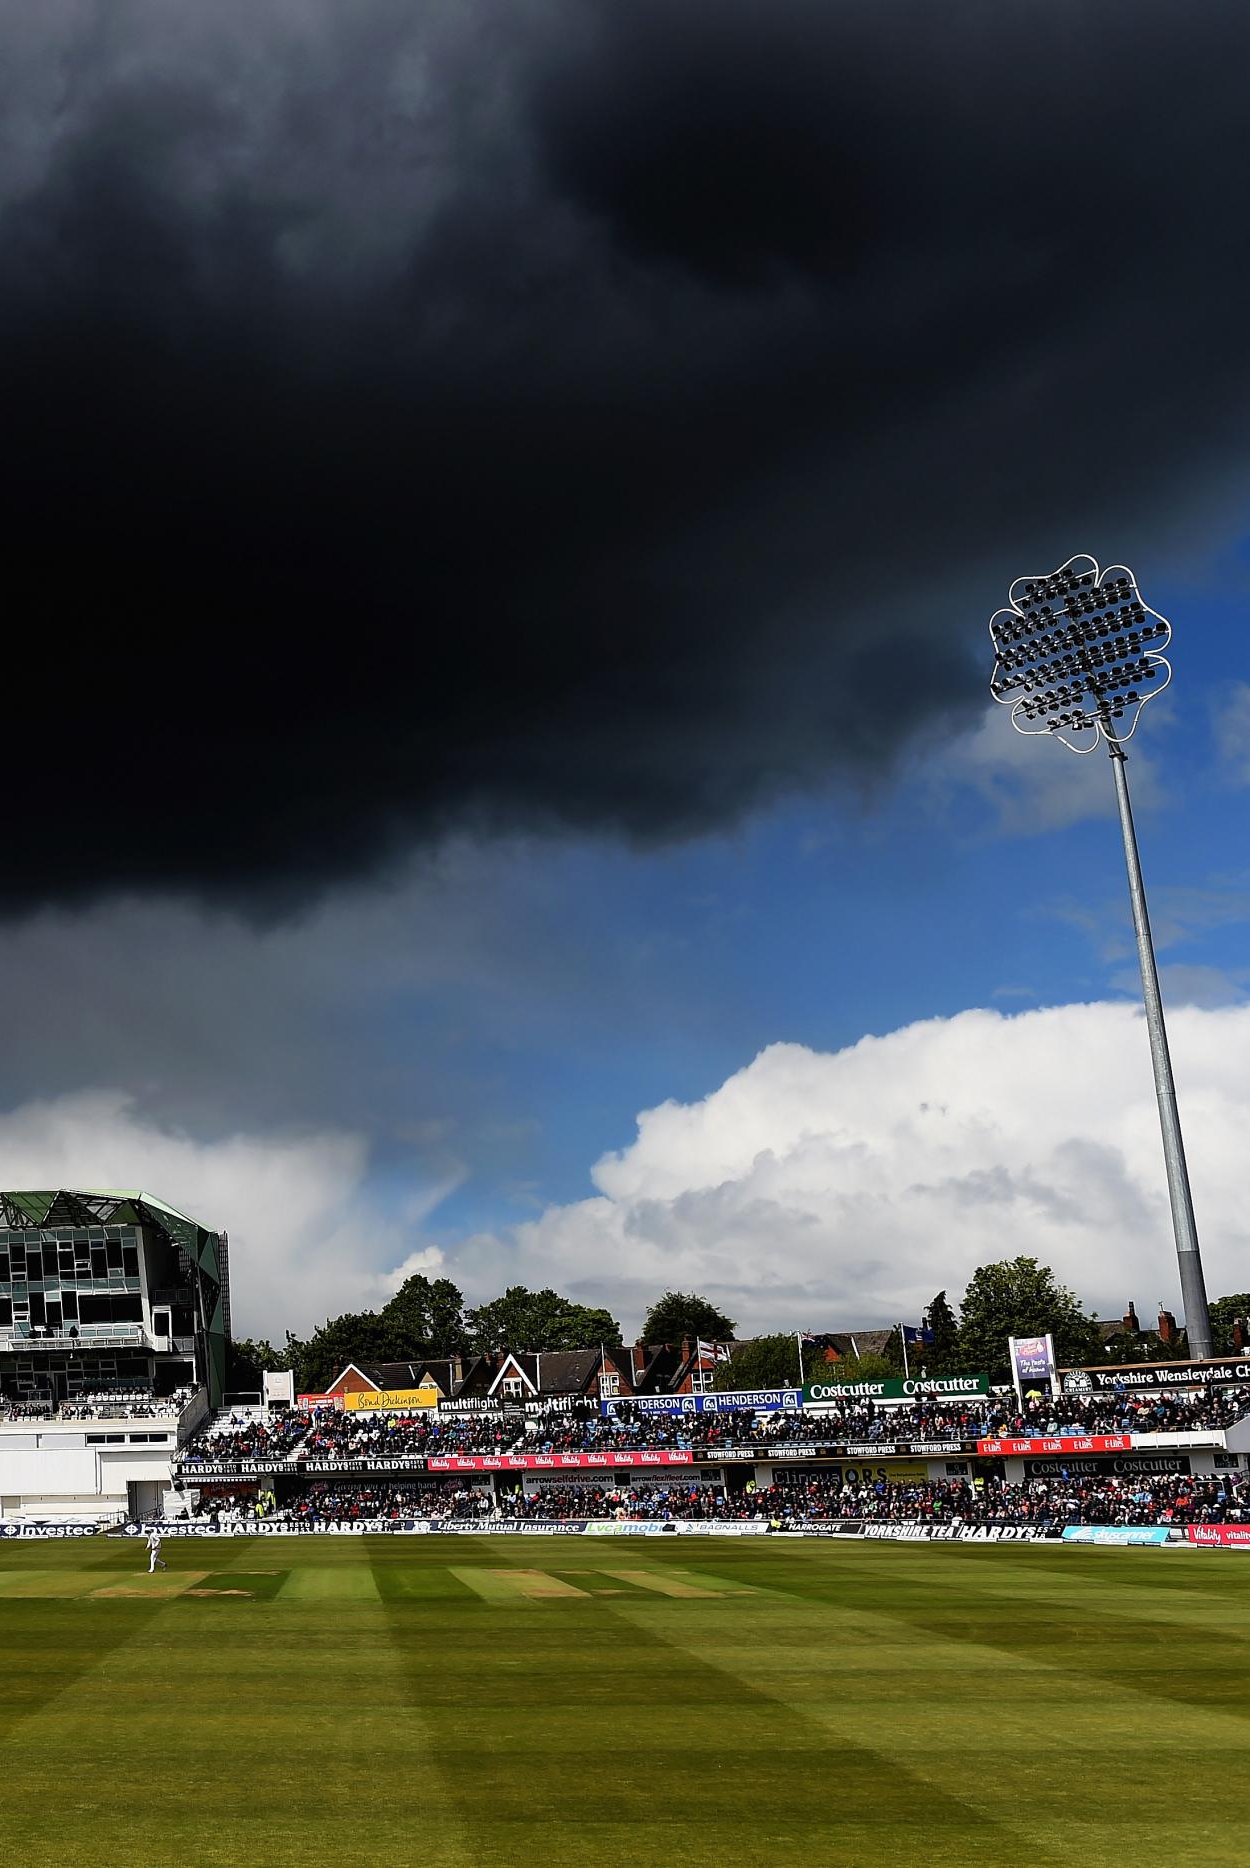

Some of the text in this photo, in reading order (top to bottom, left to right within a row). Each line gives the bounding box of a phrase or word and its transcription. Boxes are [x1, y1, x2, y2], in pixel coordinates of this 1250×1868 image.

[1096, 1372, 1154, 1386] Yorkshire
[1155, 1366, 1233, 1383] Wensleydale
[810, 1383, 884, 1399] Costcutter
[902, 1378, 979, 1395] Costcutter
[357, 1391, 422, 1409] Bond Dickinson
[440, 1397, 499, 1411] multiflight
[719, 1393, 781, 1406] HENDERSON
[768, 1448, 816, 1457] STOWFORD PRESS
[847, 1445, 896, 1455] STOWFORD PRESS
[910, 1443, 961, 1453] STOWFORD PRESS
[561, 1454, 580, 1466] Vitality
[588, 1454, 607, 1466] Vitality
[614, 1453, 634, 1464] Vitality
[641, 1452, 660, 1463] Vitality
[668, 1451, 688, 1463] Vitality
[707, 1450, 754, 1459] STOWFORD PRESS
[306, 1462, 349, 1471] HARDYS
[367, 1460, 410, 1470] HARDYS
[432, 1457, 450, 1469] Vitality
[457, 1457, 475, 1468] Vitality
[483, 1456, 501, 1468] Vitality
[509, 1455, 527, 1467] Vitality
[535, 1455, 554, 1467] Vitality
[1113, 1459, 1182, 1472] Costcutter
[182, 1465, 223, 1474] HARDYS
[241, 1463, 283, 1473] HARDYS
[1031, 1461, 1098, 1475] Costcutter
[526, 1474, 613, 1484] arrowselfdrive.com
[632, 1474, 700, 1482] arrowflexifleet.com
[774, 1471, 841, 1484] Clinova
[334, 1482, 361, 1491] Giving
[388, 1482, 417, 1491] helping
[417, 1481, 437, 1489] hand
[19, 1524, 94, 1536] Investec
[140, 1523, 216, 1535] Investec
[219, 1522, 288, 1533] HARDYS
[313, 1521, 383, 1532] HARDYS
[437, 1521, 580, 1532] Liberty Mutual Insurance
[587, 1522, 663, 1533] Lycamobi
[788, 1523, 842, 1532] HARROGATE
[864, 1525, 954, 1537] YORKSHIRE TEA
[958, 1525, 1036, 1539] HARDYS
[1093, 1528, 1156, 1540] skyscanner
[1193, 1526, 1221, 1544] Vitality
